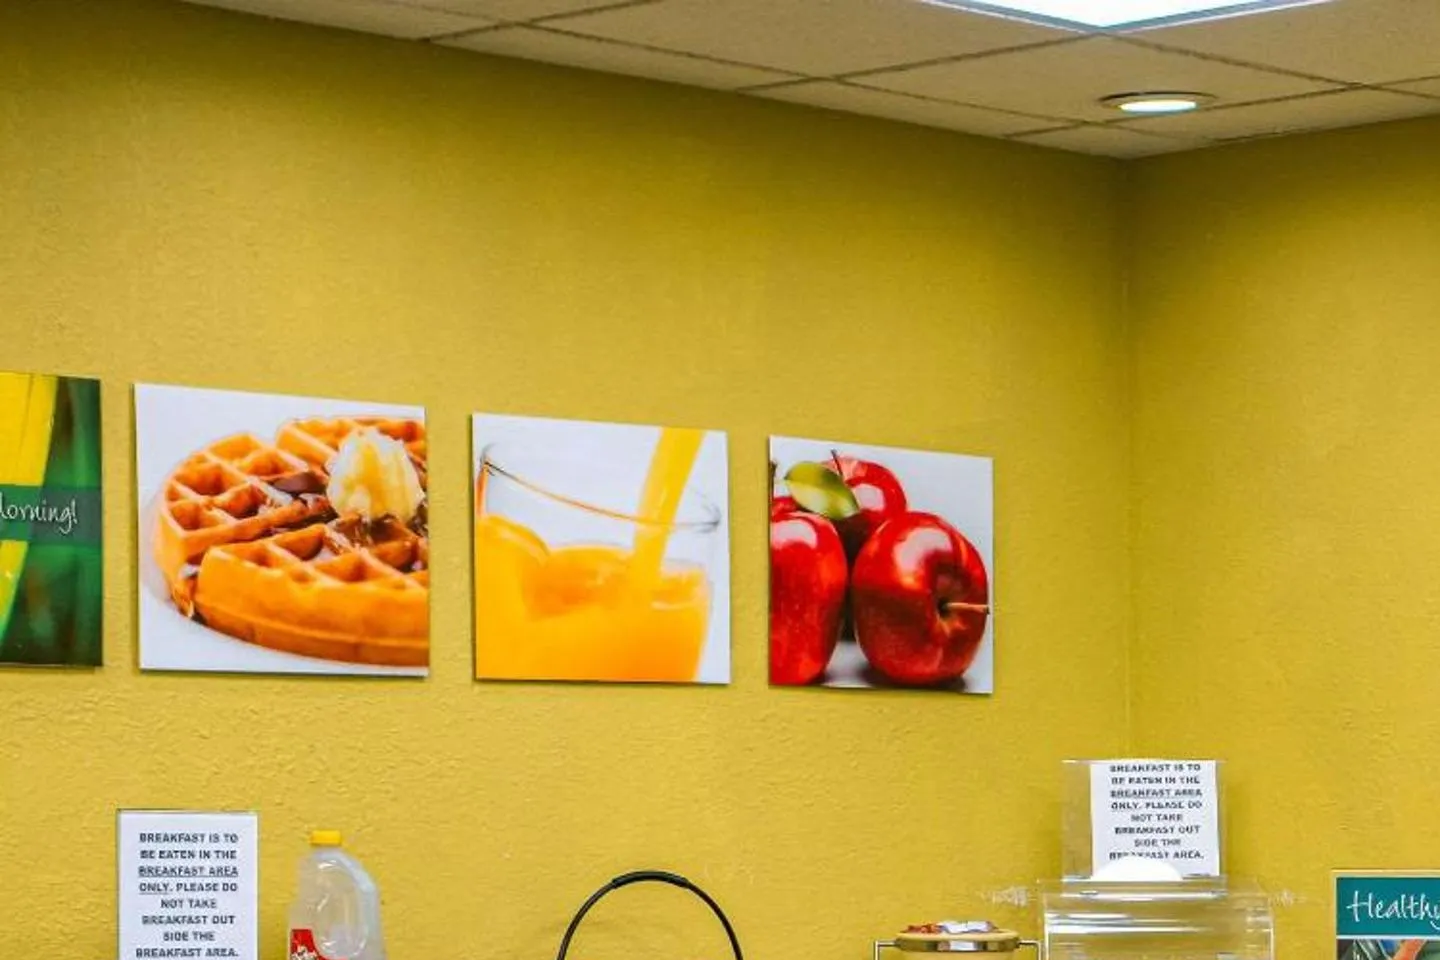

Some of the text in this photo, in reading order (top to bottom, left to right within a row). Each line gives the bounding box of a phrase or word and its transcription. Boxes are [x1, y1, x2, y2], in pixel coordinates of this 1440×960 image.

[0, 492, 78, 534] orning!
[1109, 764, 1170, 772] BREAKFAST
[1111, 777, 1125, 785] BE
[1109, 789, 1203, 798] BREAKFAST AREA
[1111, 801, 1202, 810] ONLY. PLEASE DO
[1131, 814, 1183, 822] NOT TAKE
[1114, 826, 1200, 835] BREAKFAST OUT
[139, 833, 239, 843] BREAKFAST IS TO
[1134, 839, 1158, 847] SIDE
[140, 850, 237, 859] BE EATEN IN THE
[1173, 851, 1204, 859] AREA.
[138, 866, 238, 877] BREAKFAST AREA
[138, 883, 238, 892] ONLY. PLEASE DO
[160, 899, 217, 908] NOT TAKE
[141, 915, 236, 925] BREAKFAST OUT
[163, 931, 215, 941] SIDE THE
[135, 948, 239, 958] BREAKFAST AREA.
